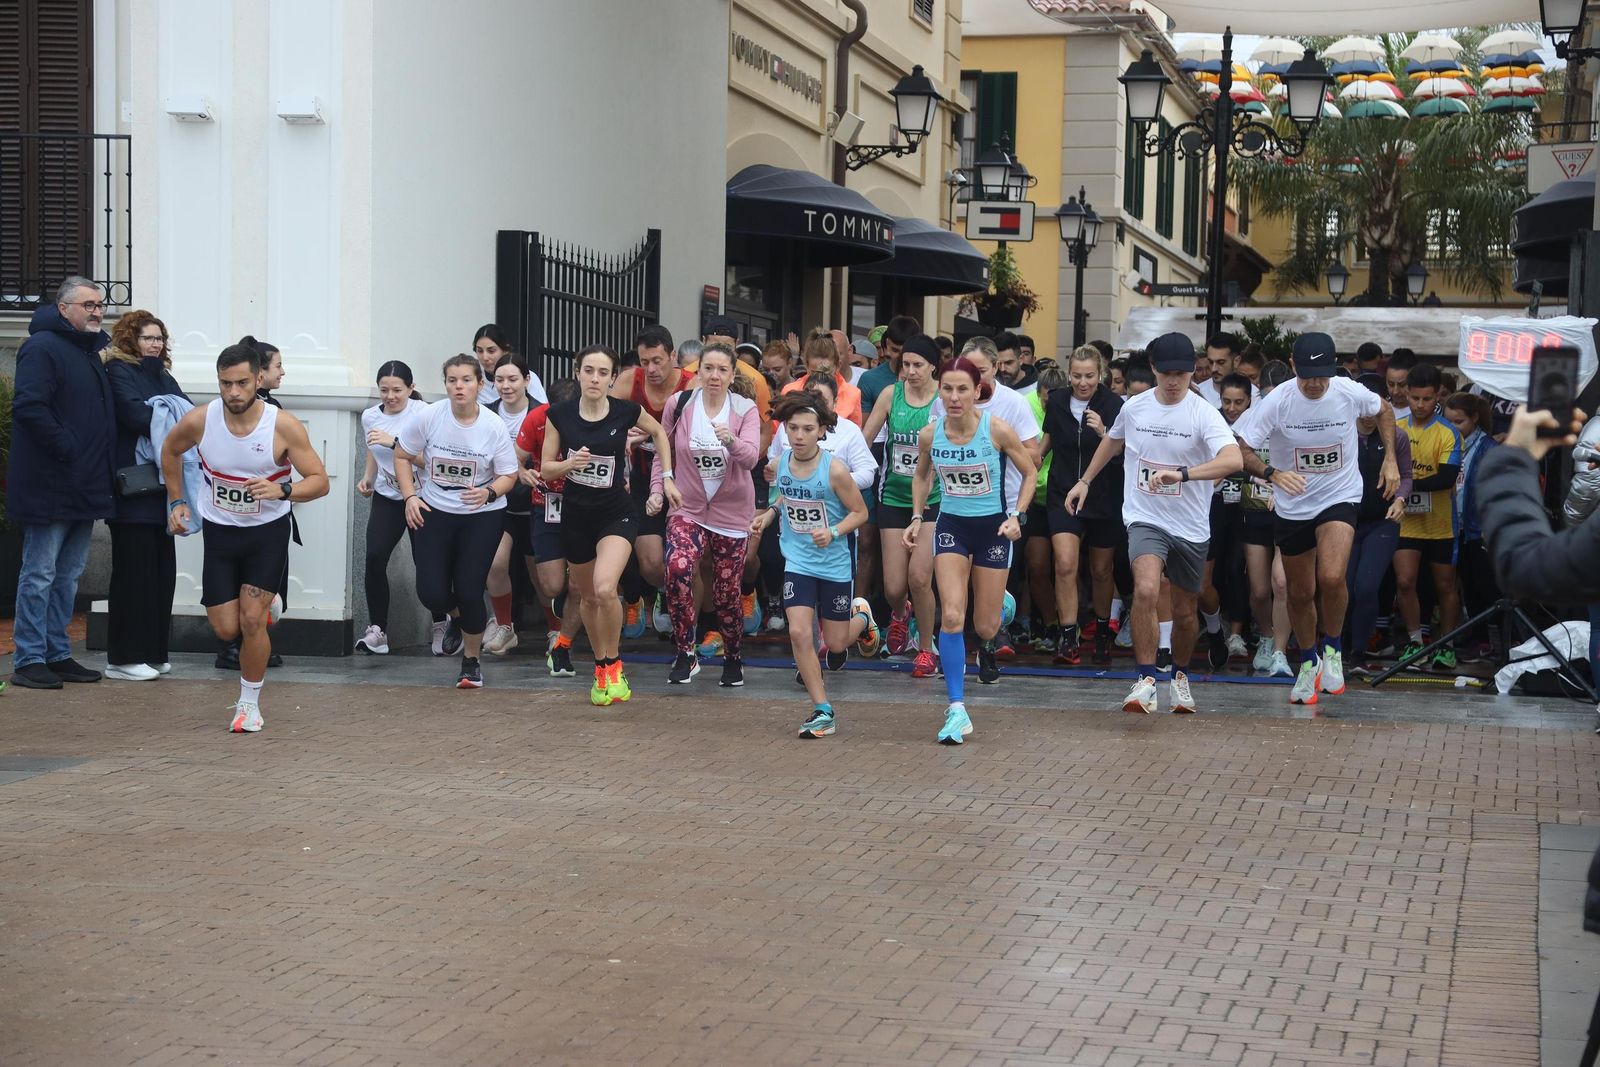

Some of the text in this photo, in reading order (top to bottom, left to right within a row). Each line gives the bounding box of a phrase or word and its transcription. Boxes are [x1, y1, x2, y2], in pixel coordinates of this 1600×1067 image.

[1558, 151, 1587, 160] GUESS
[804, 210, 881, 242] TOMMY
[1172, 286, 1193, 294] Guest
[932, 447, 977, 461] nerja
[1300, 452, 1338, 465] 188
[436, 464, 472, 477] 168
[945, 472, 984, 485] 163
[216, 485, 256, 504] 206
[780, 486, 812, 499] nerja
[787, 506, 822, 521] 283
